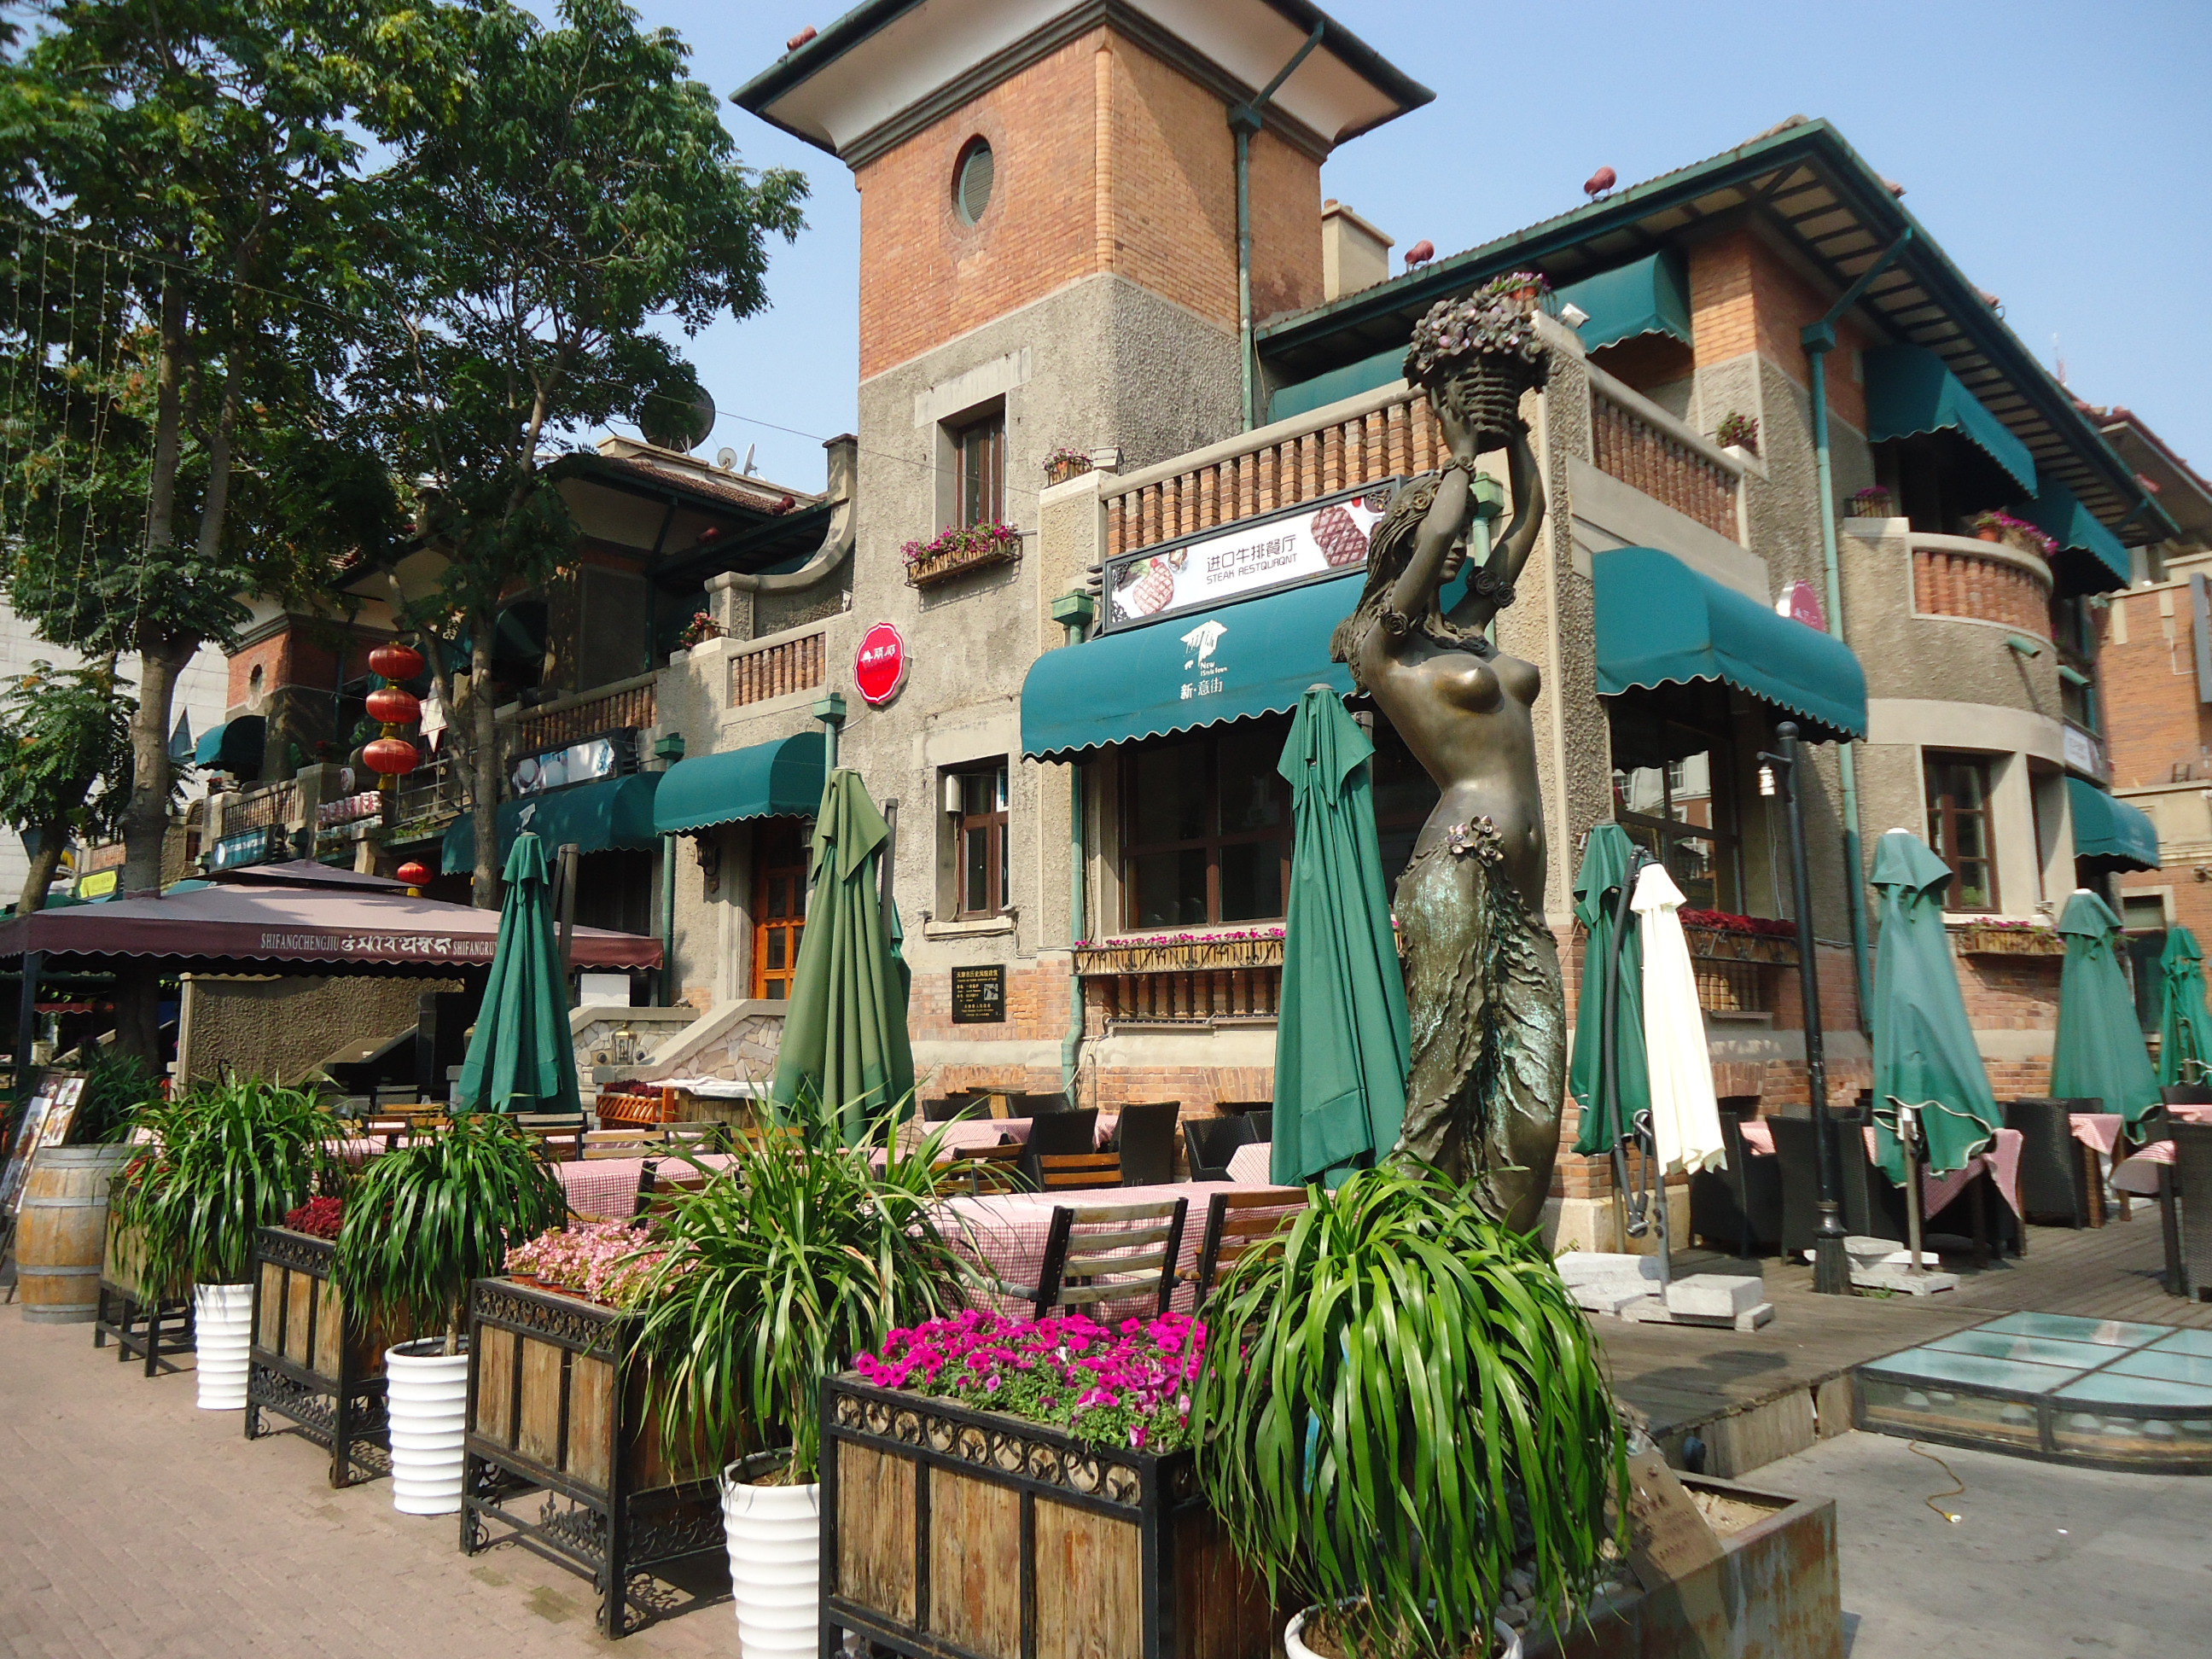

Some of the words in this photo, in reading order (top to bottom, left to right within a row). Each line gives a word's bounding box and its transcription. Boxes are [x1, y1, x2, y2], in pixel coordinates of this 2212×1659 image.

[1208, 534, 1296, 573] 进口牛排餐厅
[1207, 569, 1235, 585] STEAK
[261, 934, 340, 952] SHIFANGCHENGJIU
